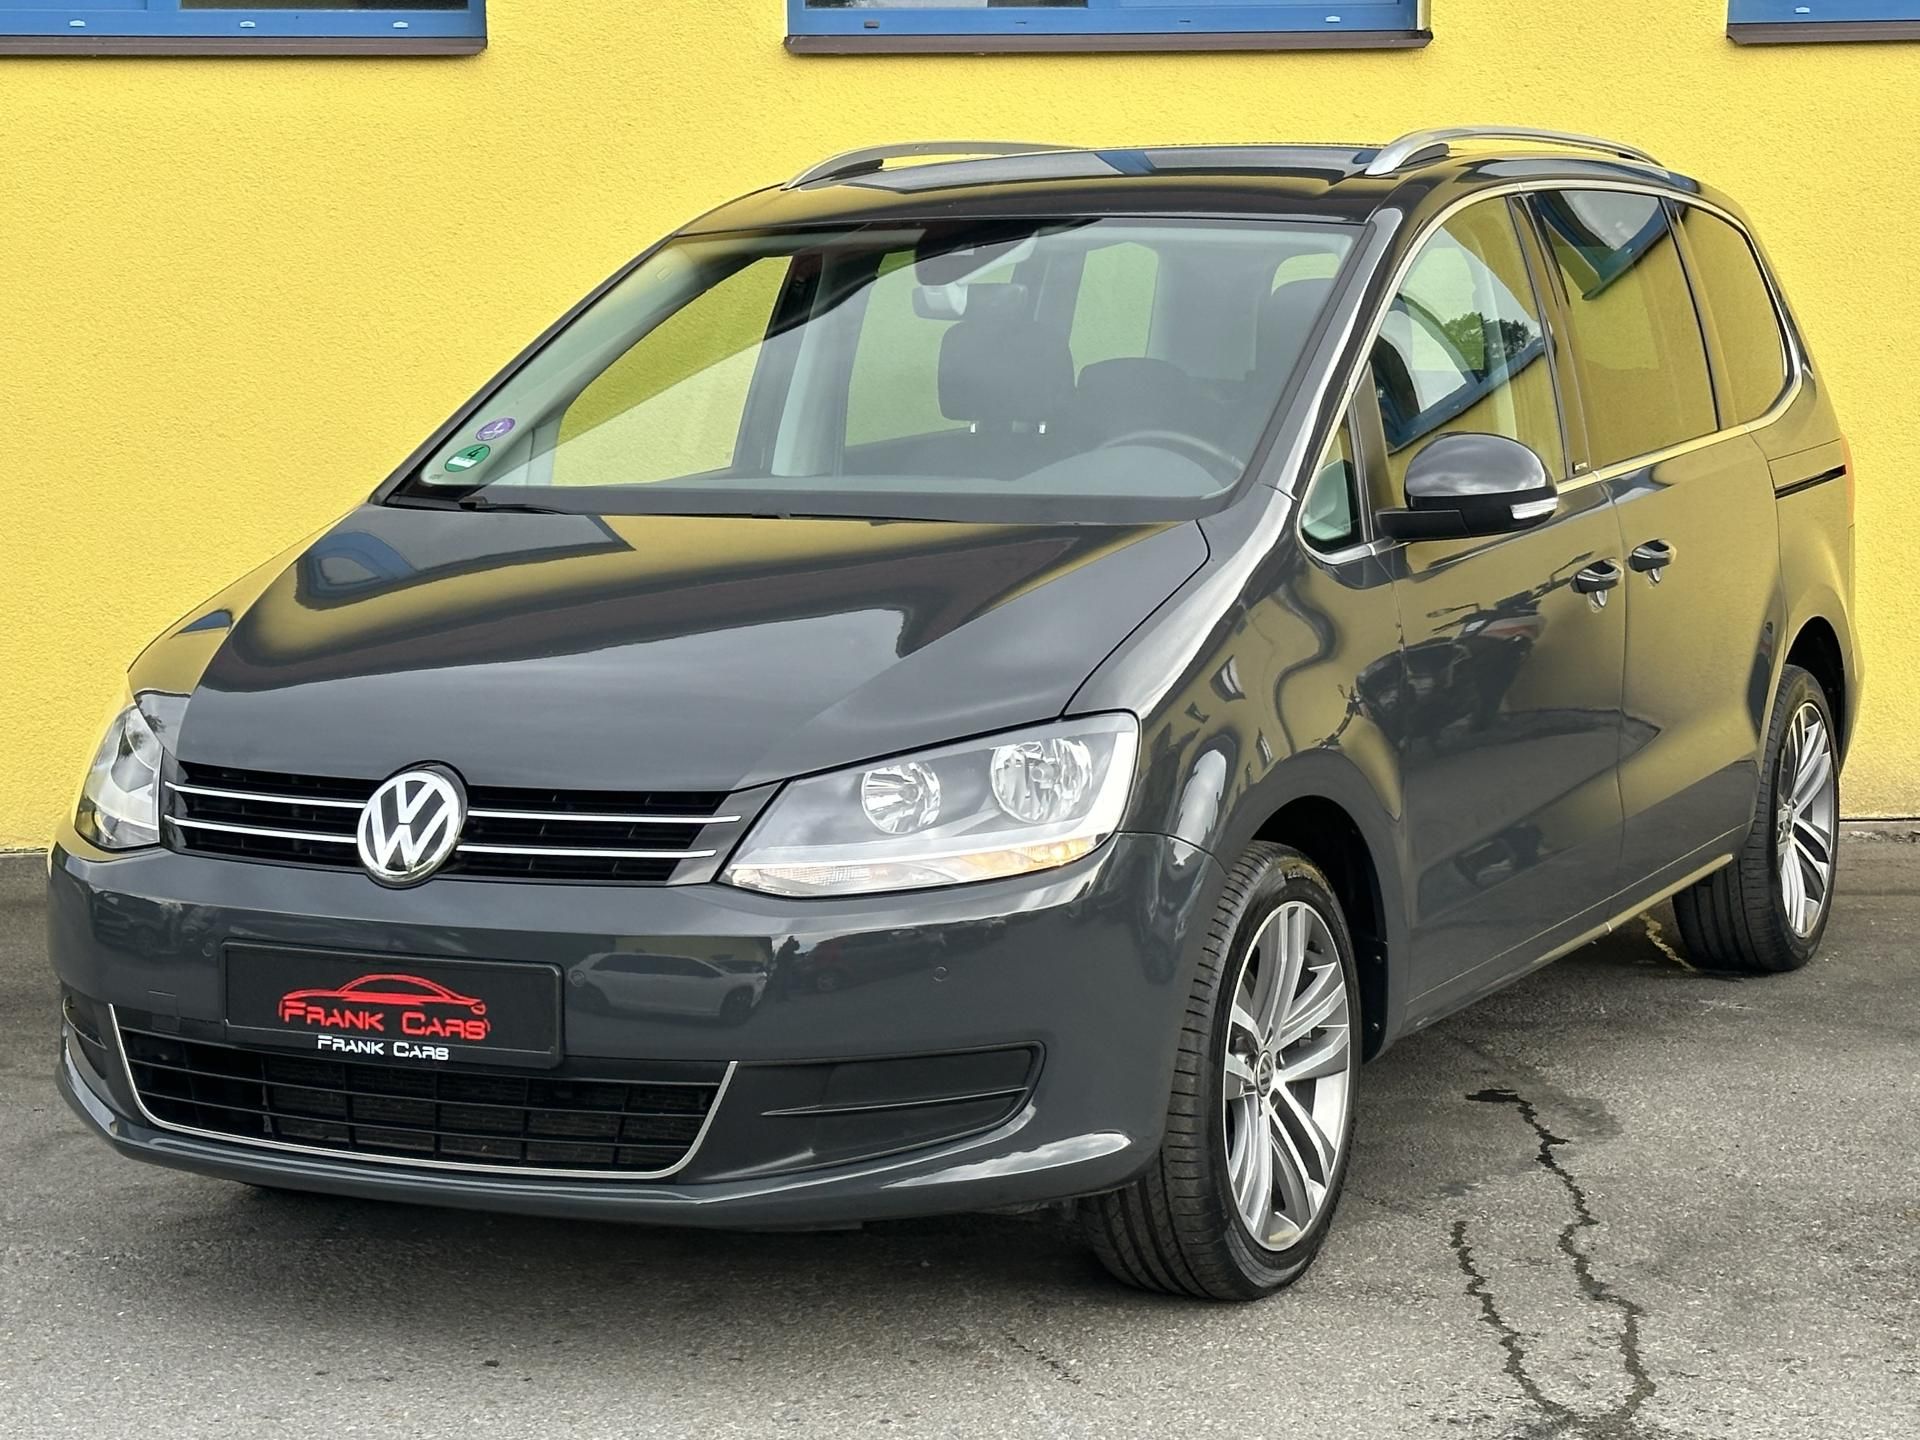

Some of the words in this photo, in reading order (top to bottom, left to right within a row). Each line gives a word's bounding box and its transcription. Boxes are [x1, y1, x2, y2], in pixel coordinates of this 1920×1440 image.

[467, 446, 485, 459] 4
[361, 773, 456, 875] VW
[284, 1001, 384, 1032] FRANK
[402, 1011, 486, 1040] CARS
[317, 1035, 385, 1056] FRANK
[393, 1041, 449, 1061] CARS
